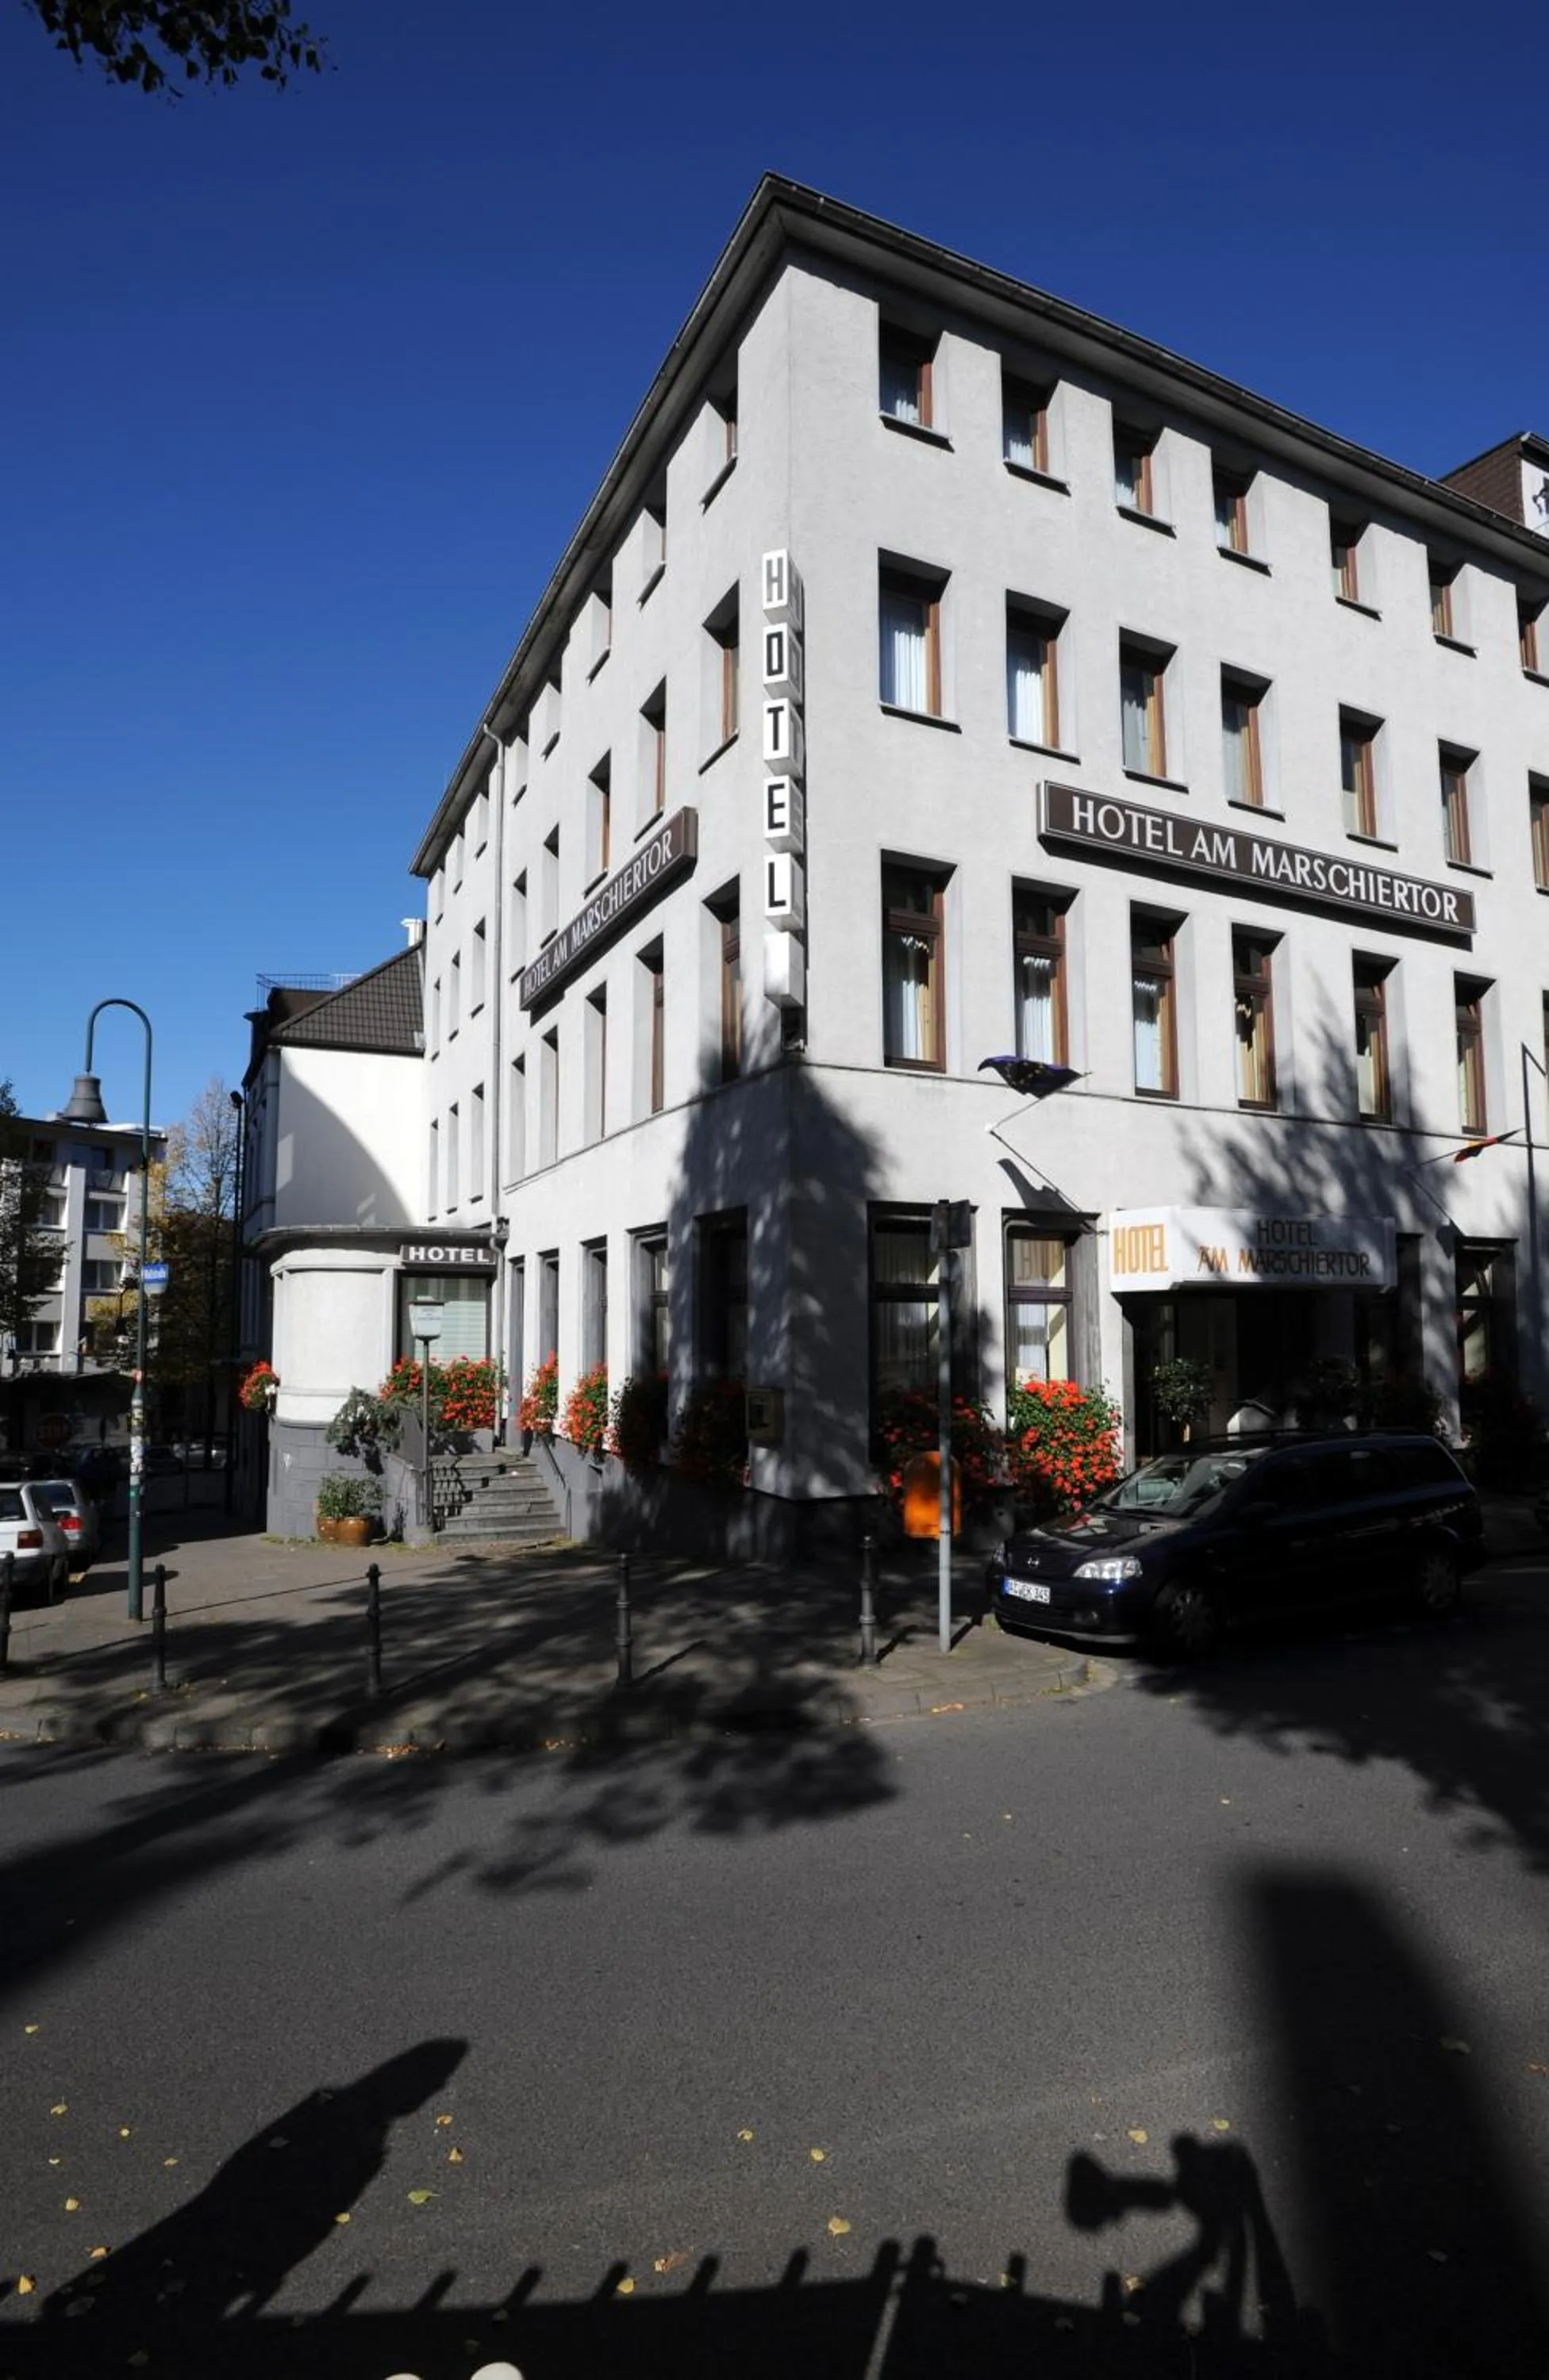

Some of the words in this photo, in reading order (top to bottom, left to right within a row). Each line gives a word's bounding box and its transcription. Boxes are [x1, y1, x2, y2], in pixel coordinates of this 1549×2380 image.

[766, 557, 786, 909] HOTEL
[1072, 796, 1183, 855] HOTEL
[1191, 831, 1237, 869] AM
[1251, 845, 1459, 923] MARSCHIERTOR
[524, 960, 551, 998] HOTEL
[552, 945, 568, 971] AM
[571, 829, 672, 952] MARSCHIERTOR
[409, 1246, 490, 1262] HOTEL
[1113, 1223, 1169, 1274] HOTEL
[1256, 1219, 1318, 1246] HOTEL
[1197, 1246, 1229, 1273] AM
[1238, 1247, 1371, 1276] MARSCHIERTOR
